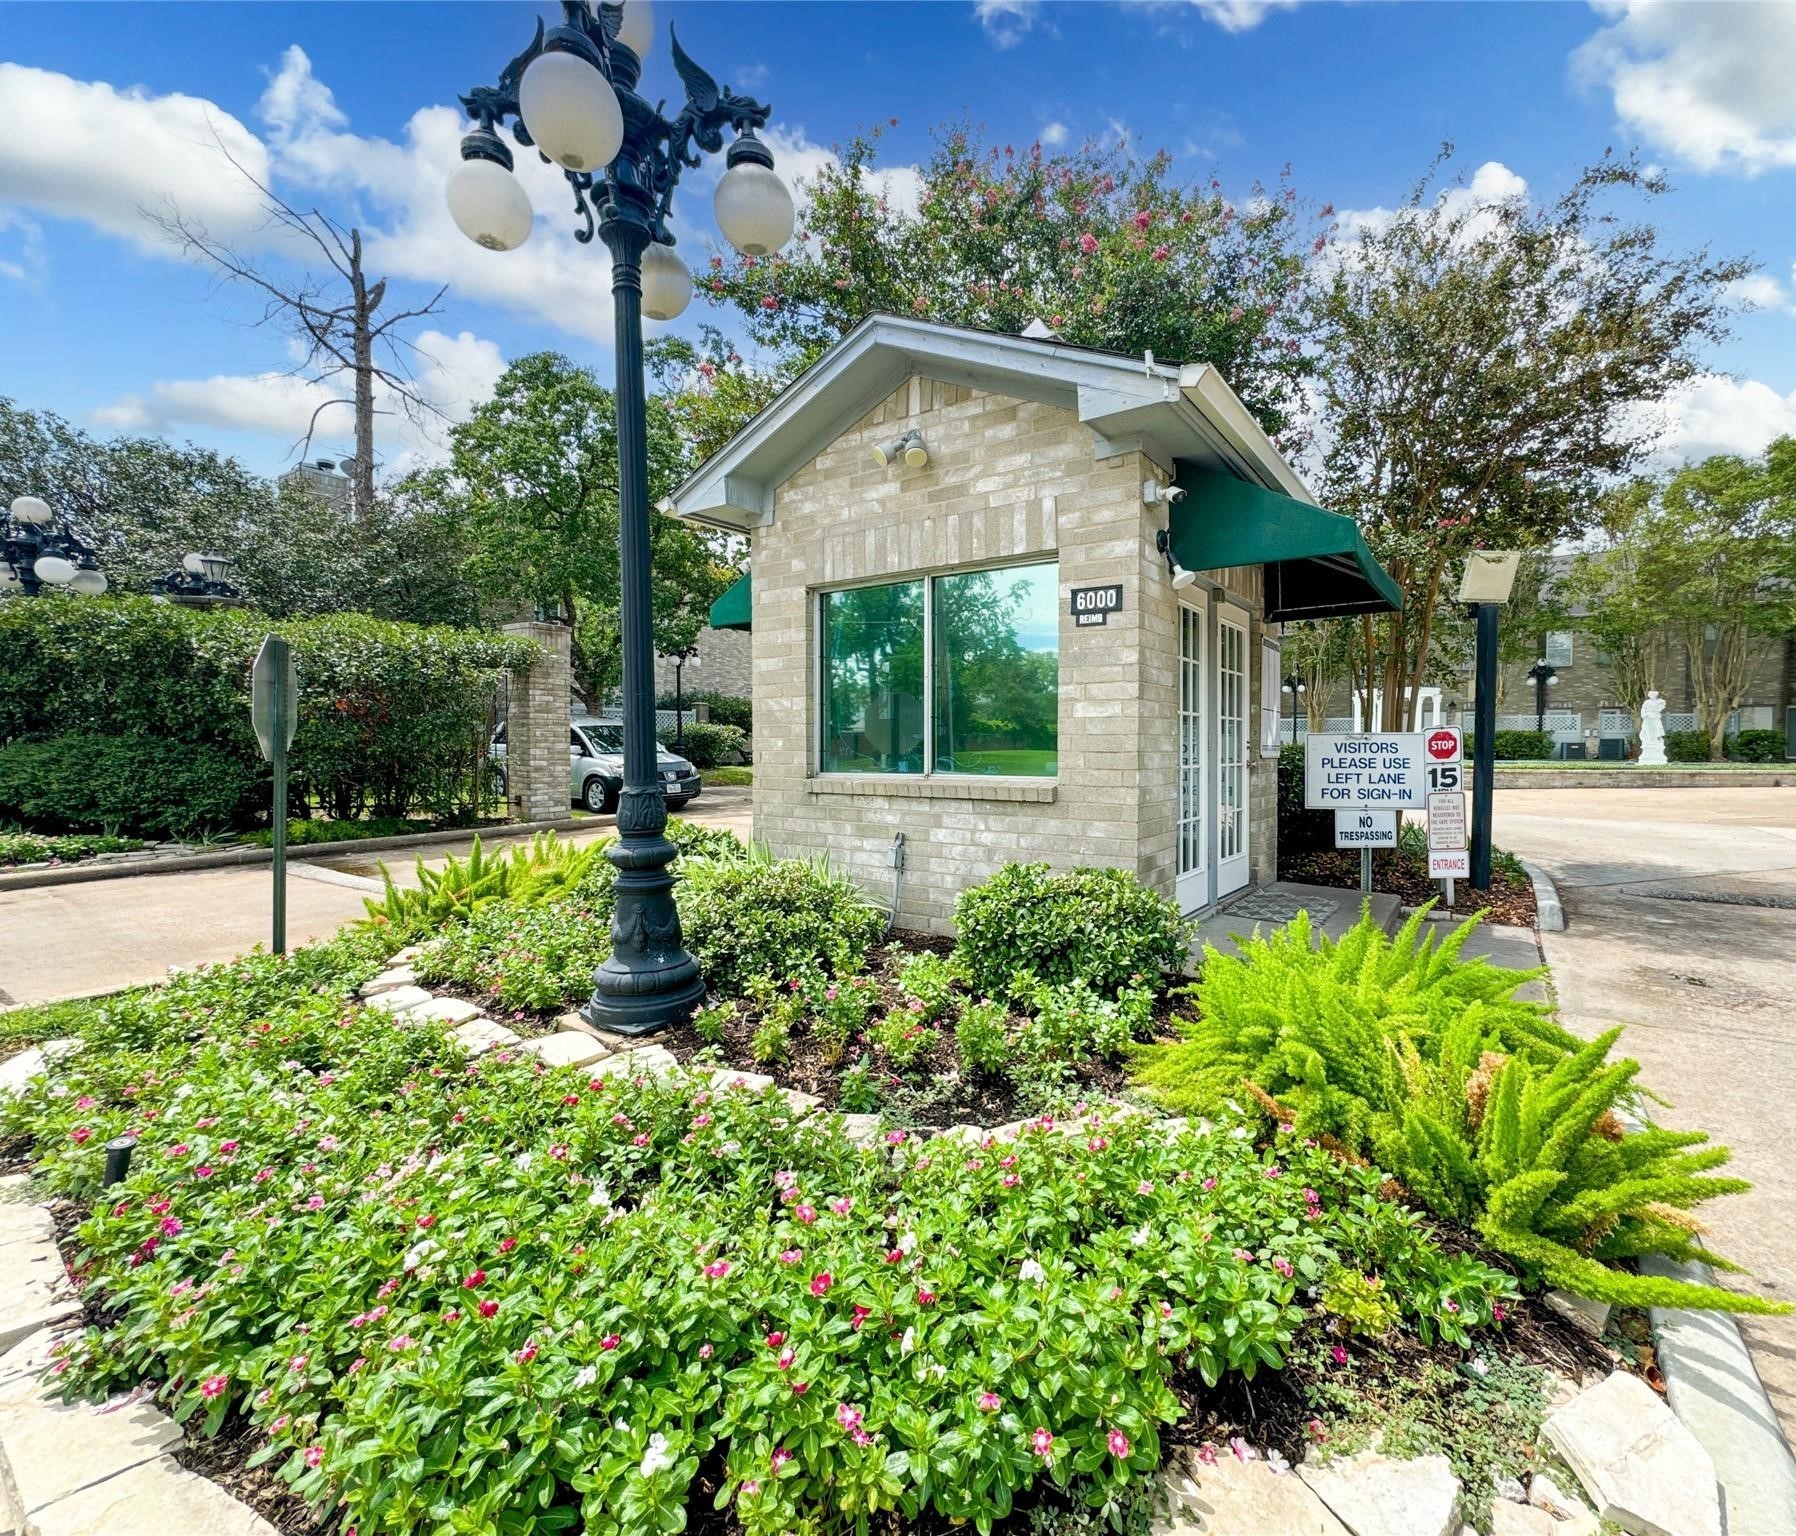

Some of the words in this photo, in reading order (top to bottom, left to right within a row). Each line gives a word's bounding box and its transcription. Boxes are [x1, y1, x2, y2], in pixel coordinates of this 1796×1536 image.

[1077, 590, 1116, 610] 6000
[1079, 614, 1103, 624] REIMS
[1334, 742, 1399, 754] VISITORS
[1431, 740, 1455, 751] STOP
[1321, 758, 1377, 769] PLEASE
[1383, 758, 1411, 769] USE
[1327, 773, 1363, 784] LEFT
[1368, 773, 1406, 784] LANE
[1427, 767, 1458, 788] 15
[1321, 788, 1351, 799] FOR
[1357, 788, 1412, 800] SIGN-IN
[1359, 816, 1373, 828] NO
[1339, 831, 1393, 841] TRESPASSING
[1432, 858, 1465, 871] ENTRANCE
